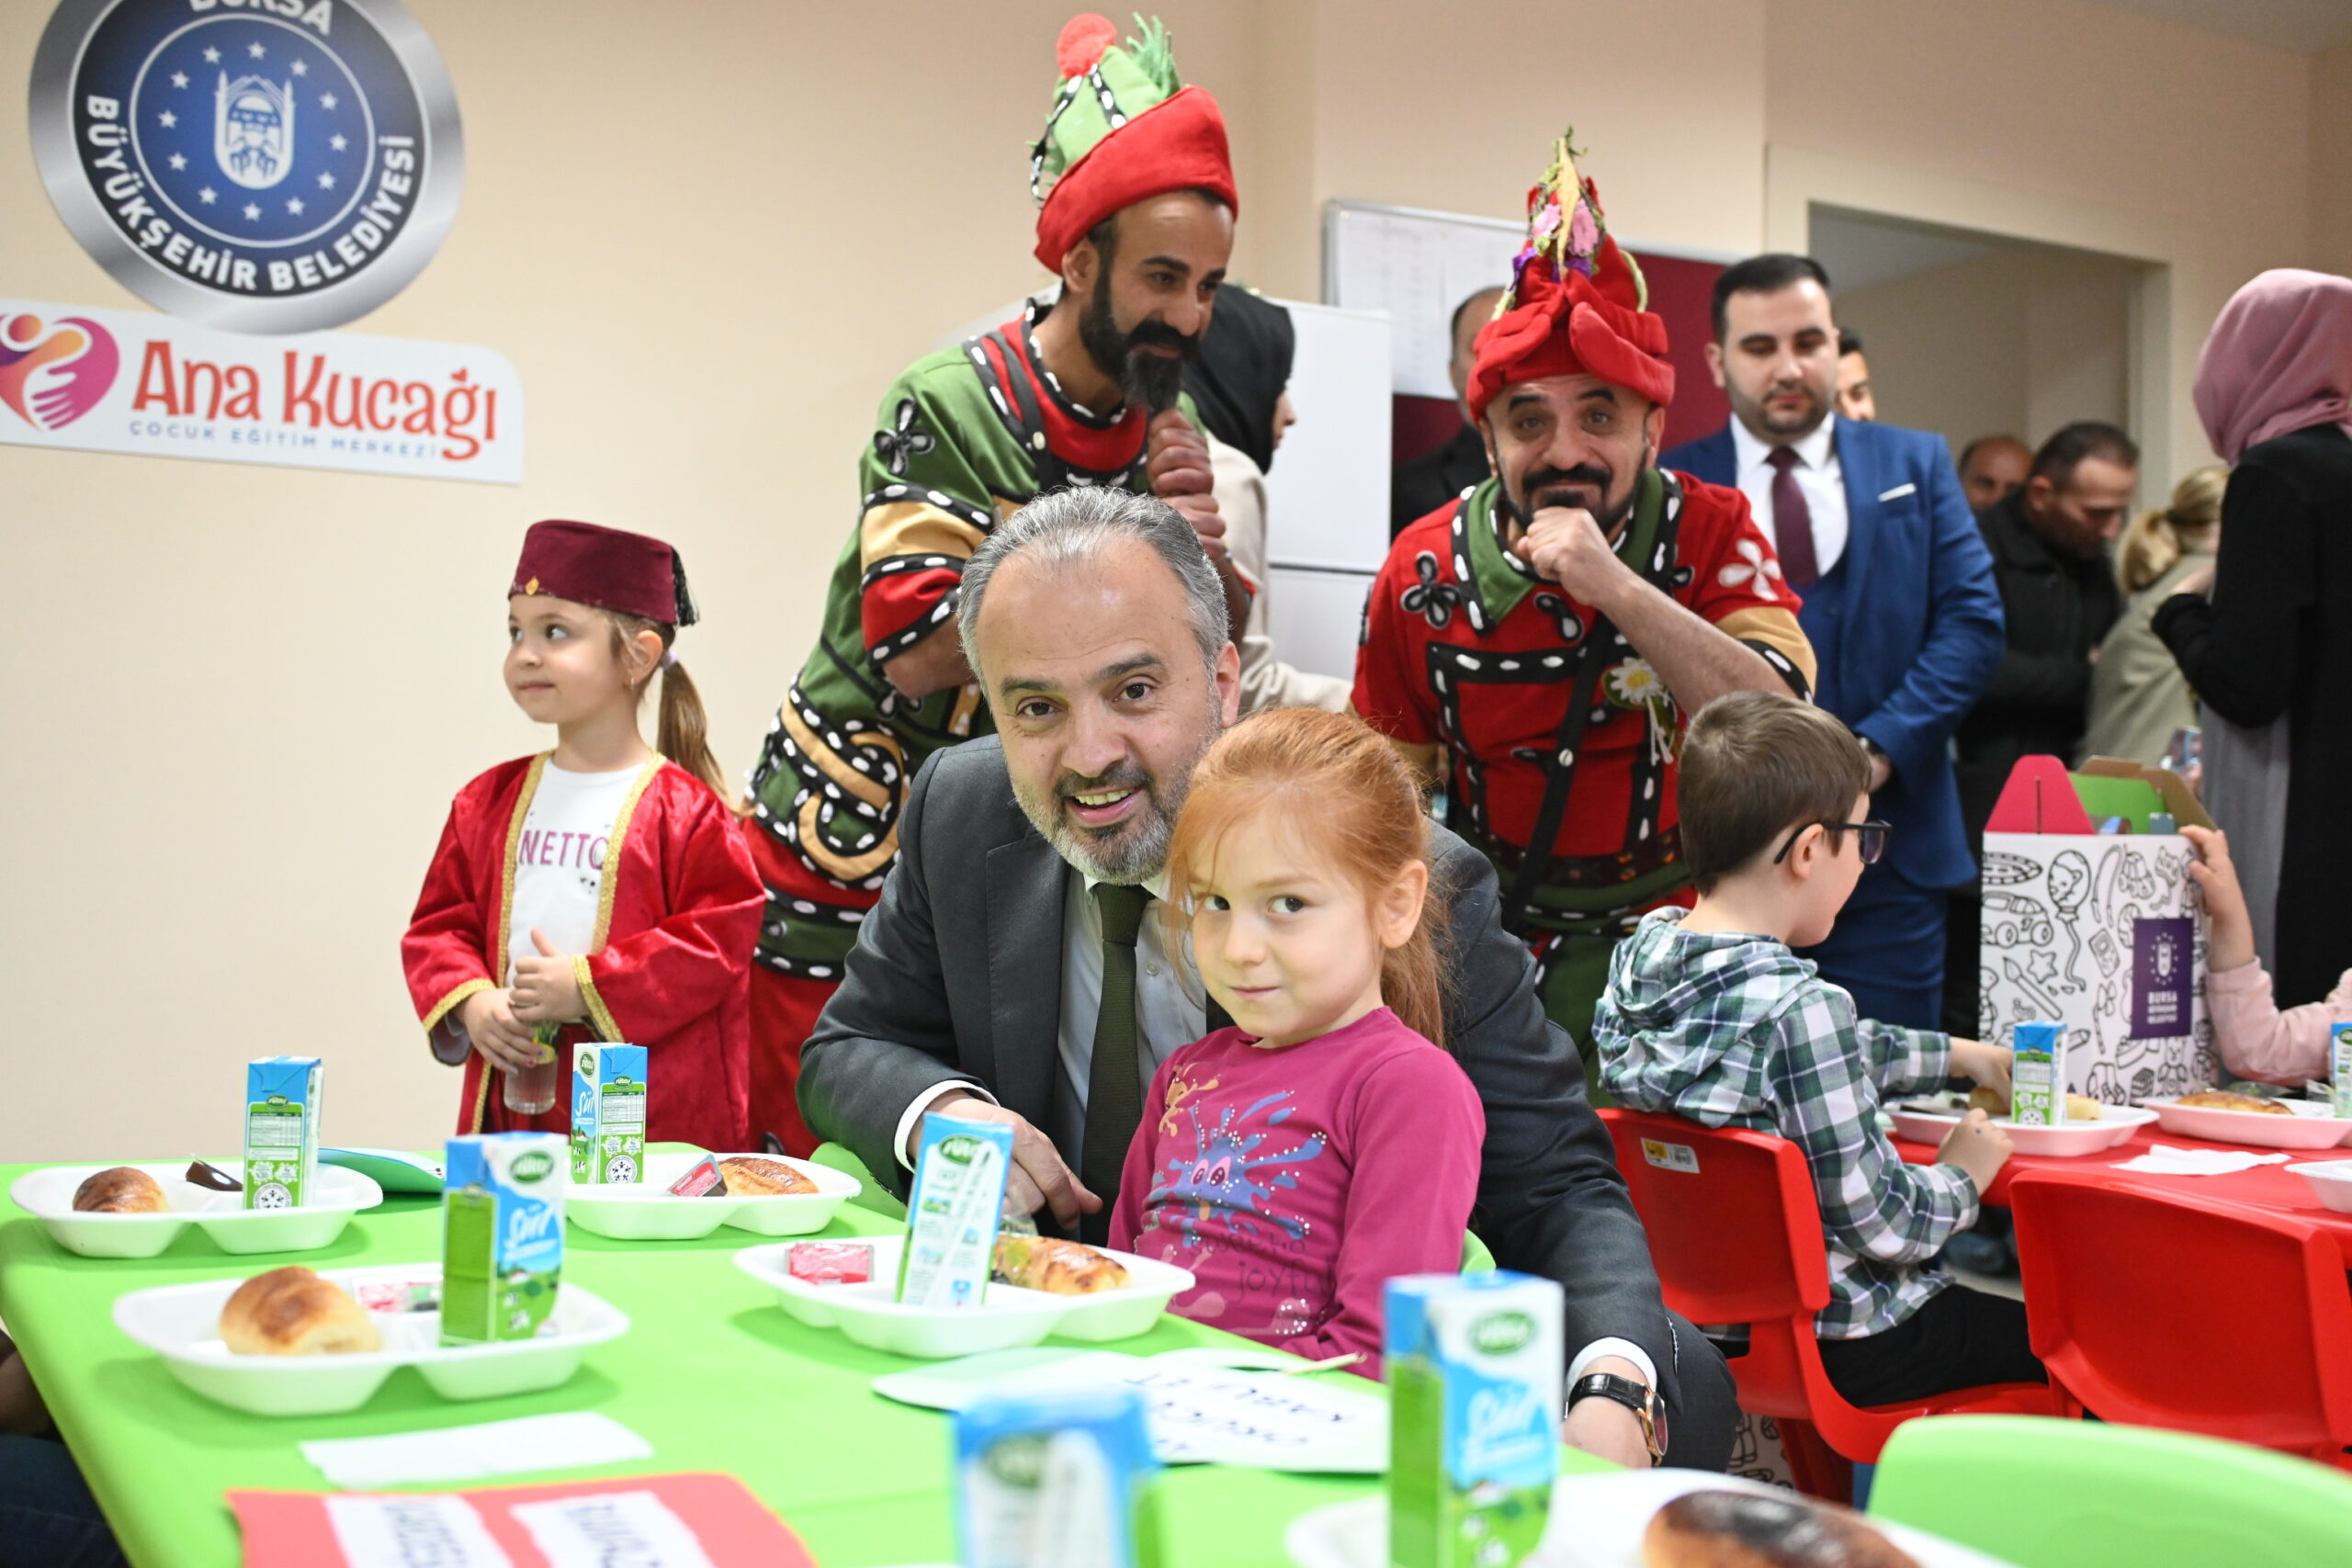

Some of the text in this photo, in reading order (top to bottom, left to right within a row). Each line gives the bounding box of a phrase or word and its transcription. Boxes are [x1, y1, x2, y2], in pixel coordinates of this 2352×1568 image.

[86, 95, 414, 291] BÜYÜKŞEHİR BELEDİYESİ
[129, 420, 437, 458] ÇOCUK EĞİTİM MERKEZİ
[131, 340, 496, 462] Ana Kucağı
